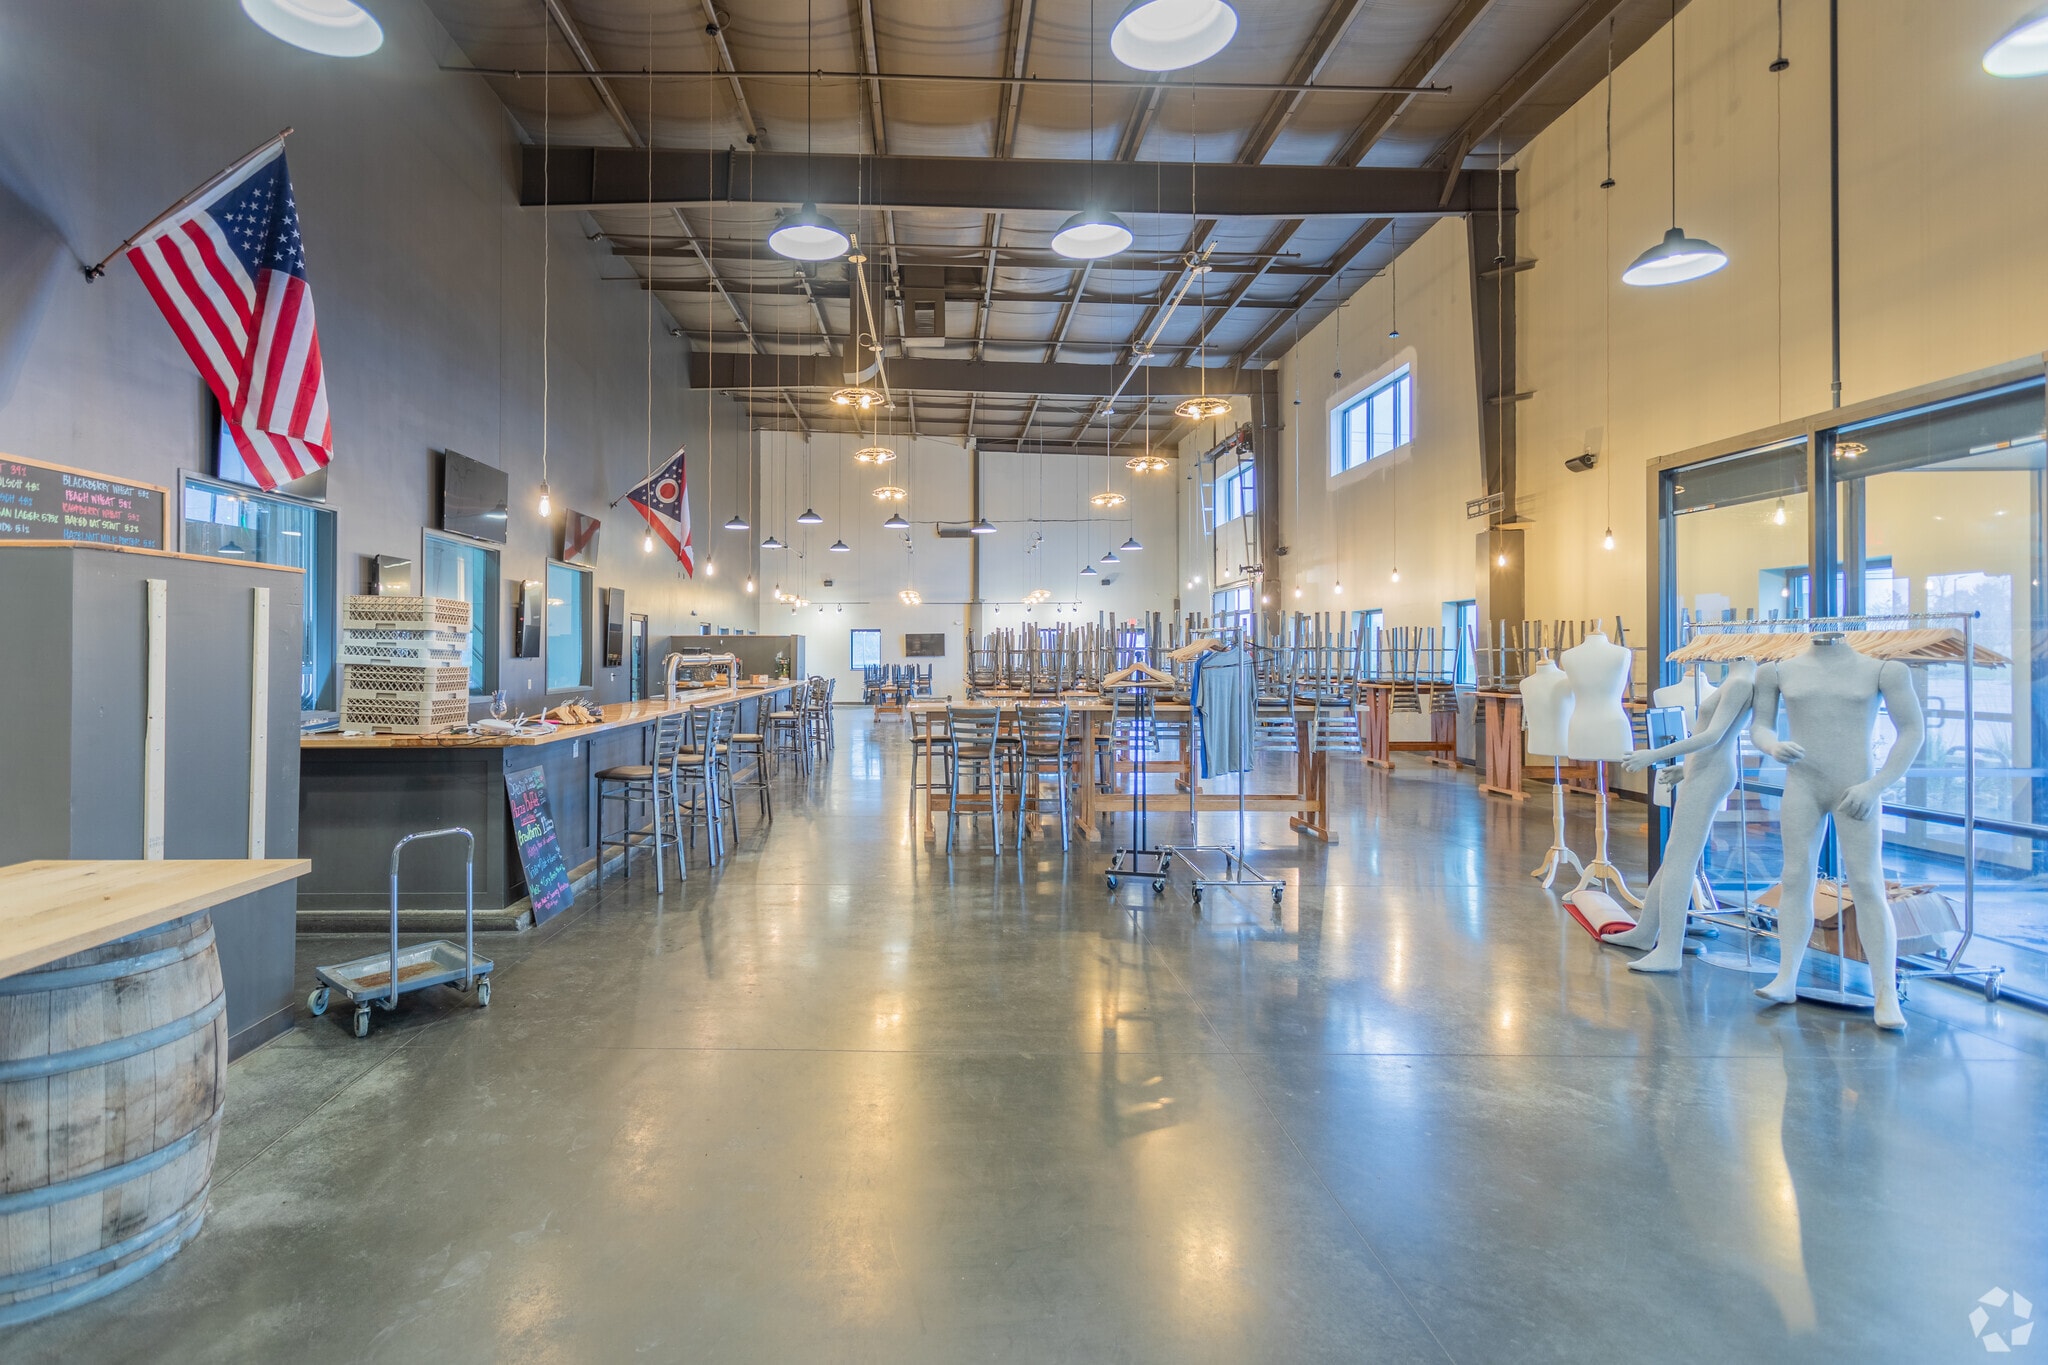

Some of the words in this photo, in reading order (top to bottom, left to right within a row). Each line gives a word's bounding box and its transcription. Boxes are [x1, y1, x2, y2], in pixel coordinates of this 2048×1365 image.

[66, 489, 89, 503] PEACH
[91, 493, 115, 507] WHEAT
[64, 515, 88, 527] BAKED
